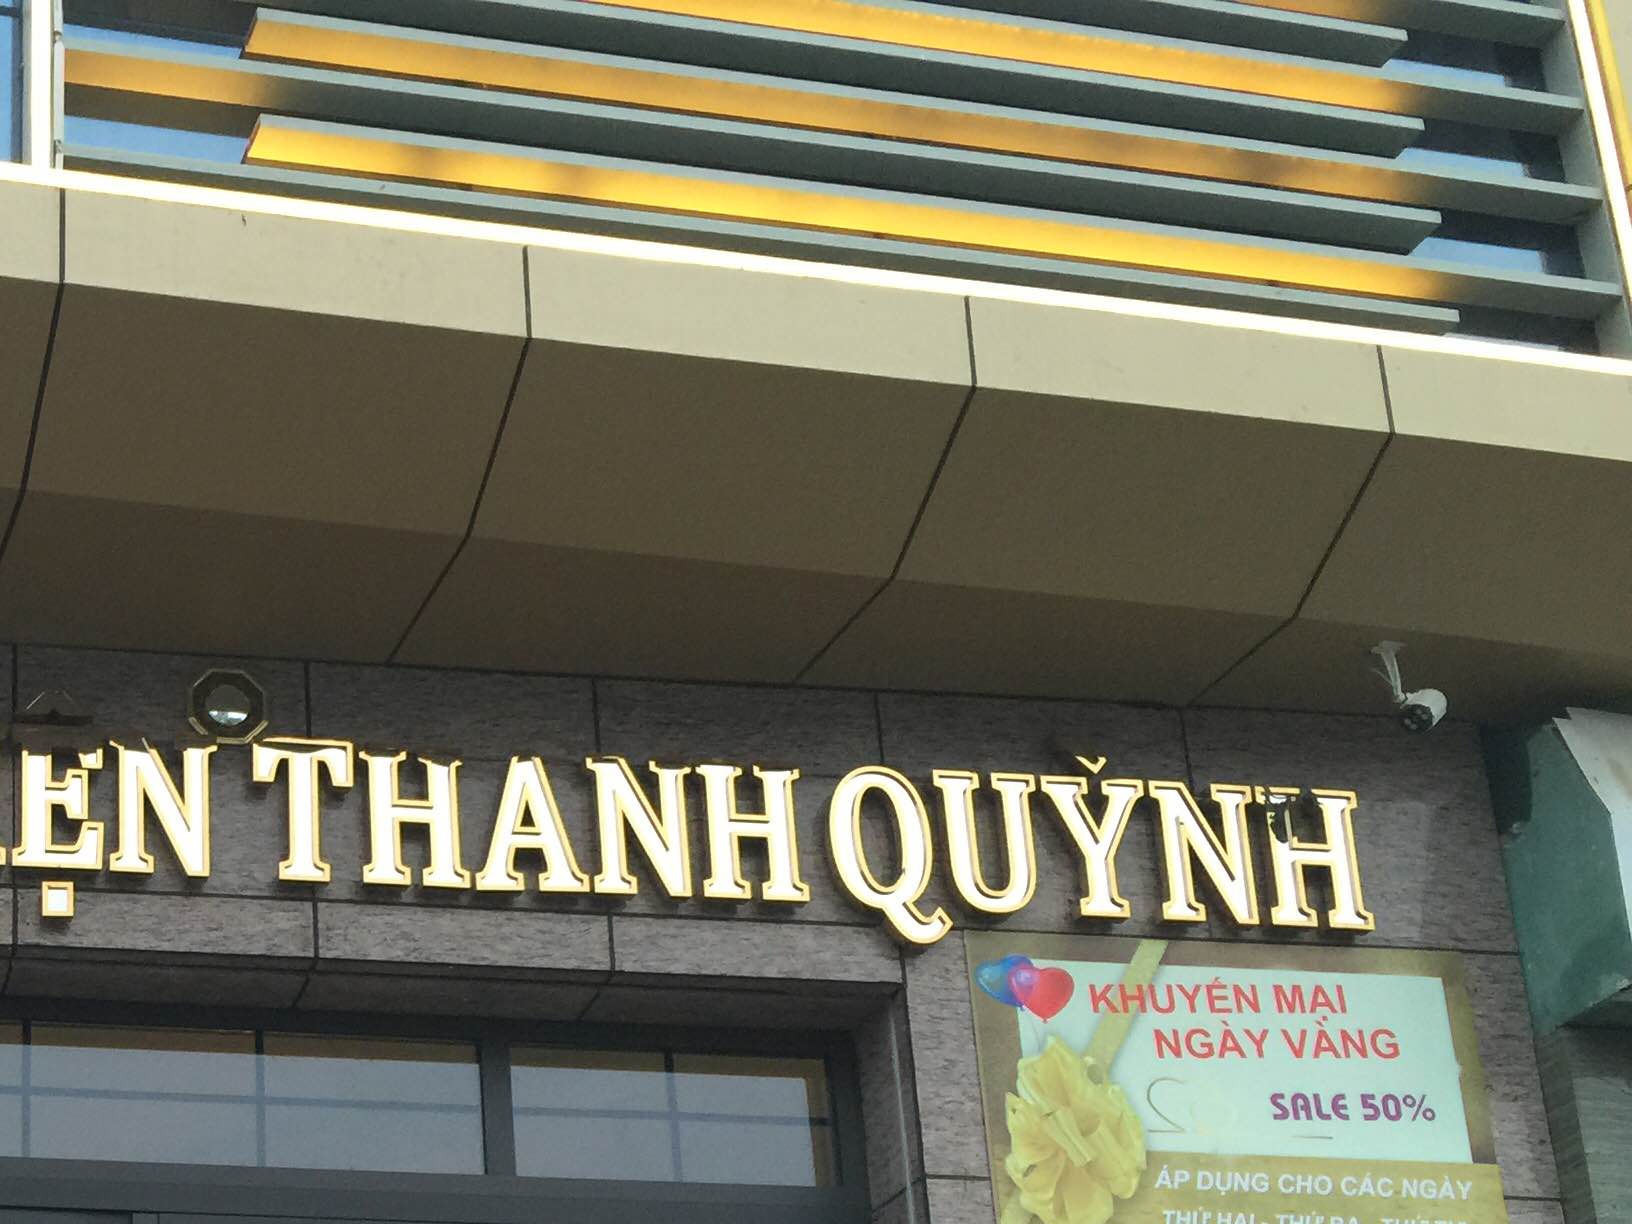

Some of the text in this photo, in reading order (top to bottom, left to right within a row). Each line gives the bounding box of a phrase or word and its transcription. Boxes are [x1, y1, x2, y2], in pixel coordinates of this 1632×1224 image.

[252, 737, 810, 903] THANH
[1088, 976, 1348, 1022] KHUYẾN MẠI
[1153, 1020, 1401, 1060] NGÀY VÀNG
[1269, 1093, 1437, 1123] SALE 50%
[1154, 1164, 1473, 1201] ÁP DỤNG CHO CÁC NGÀY
